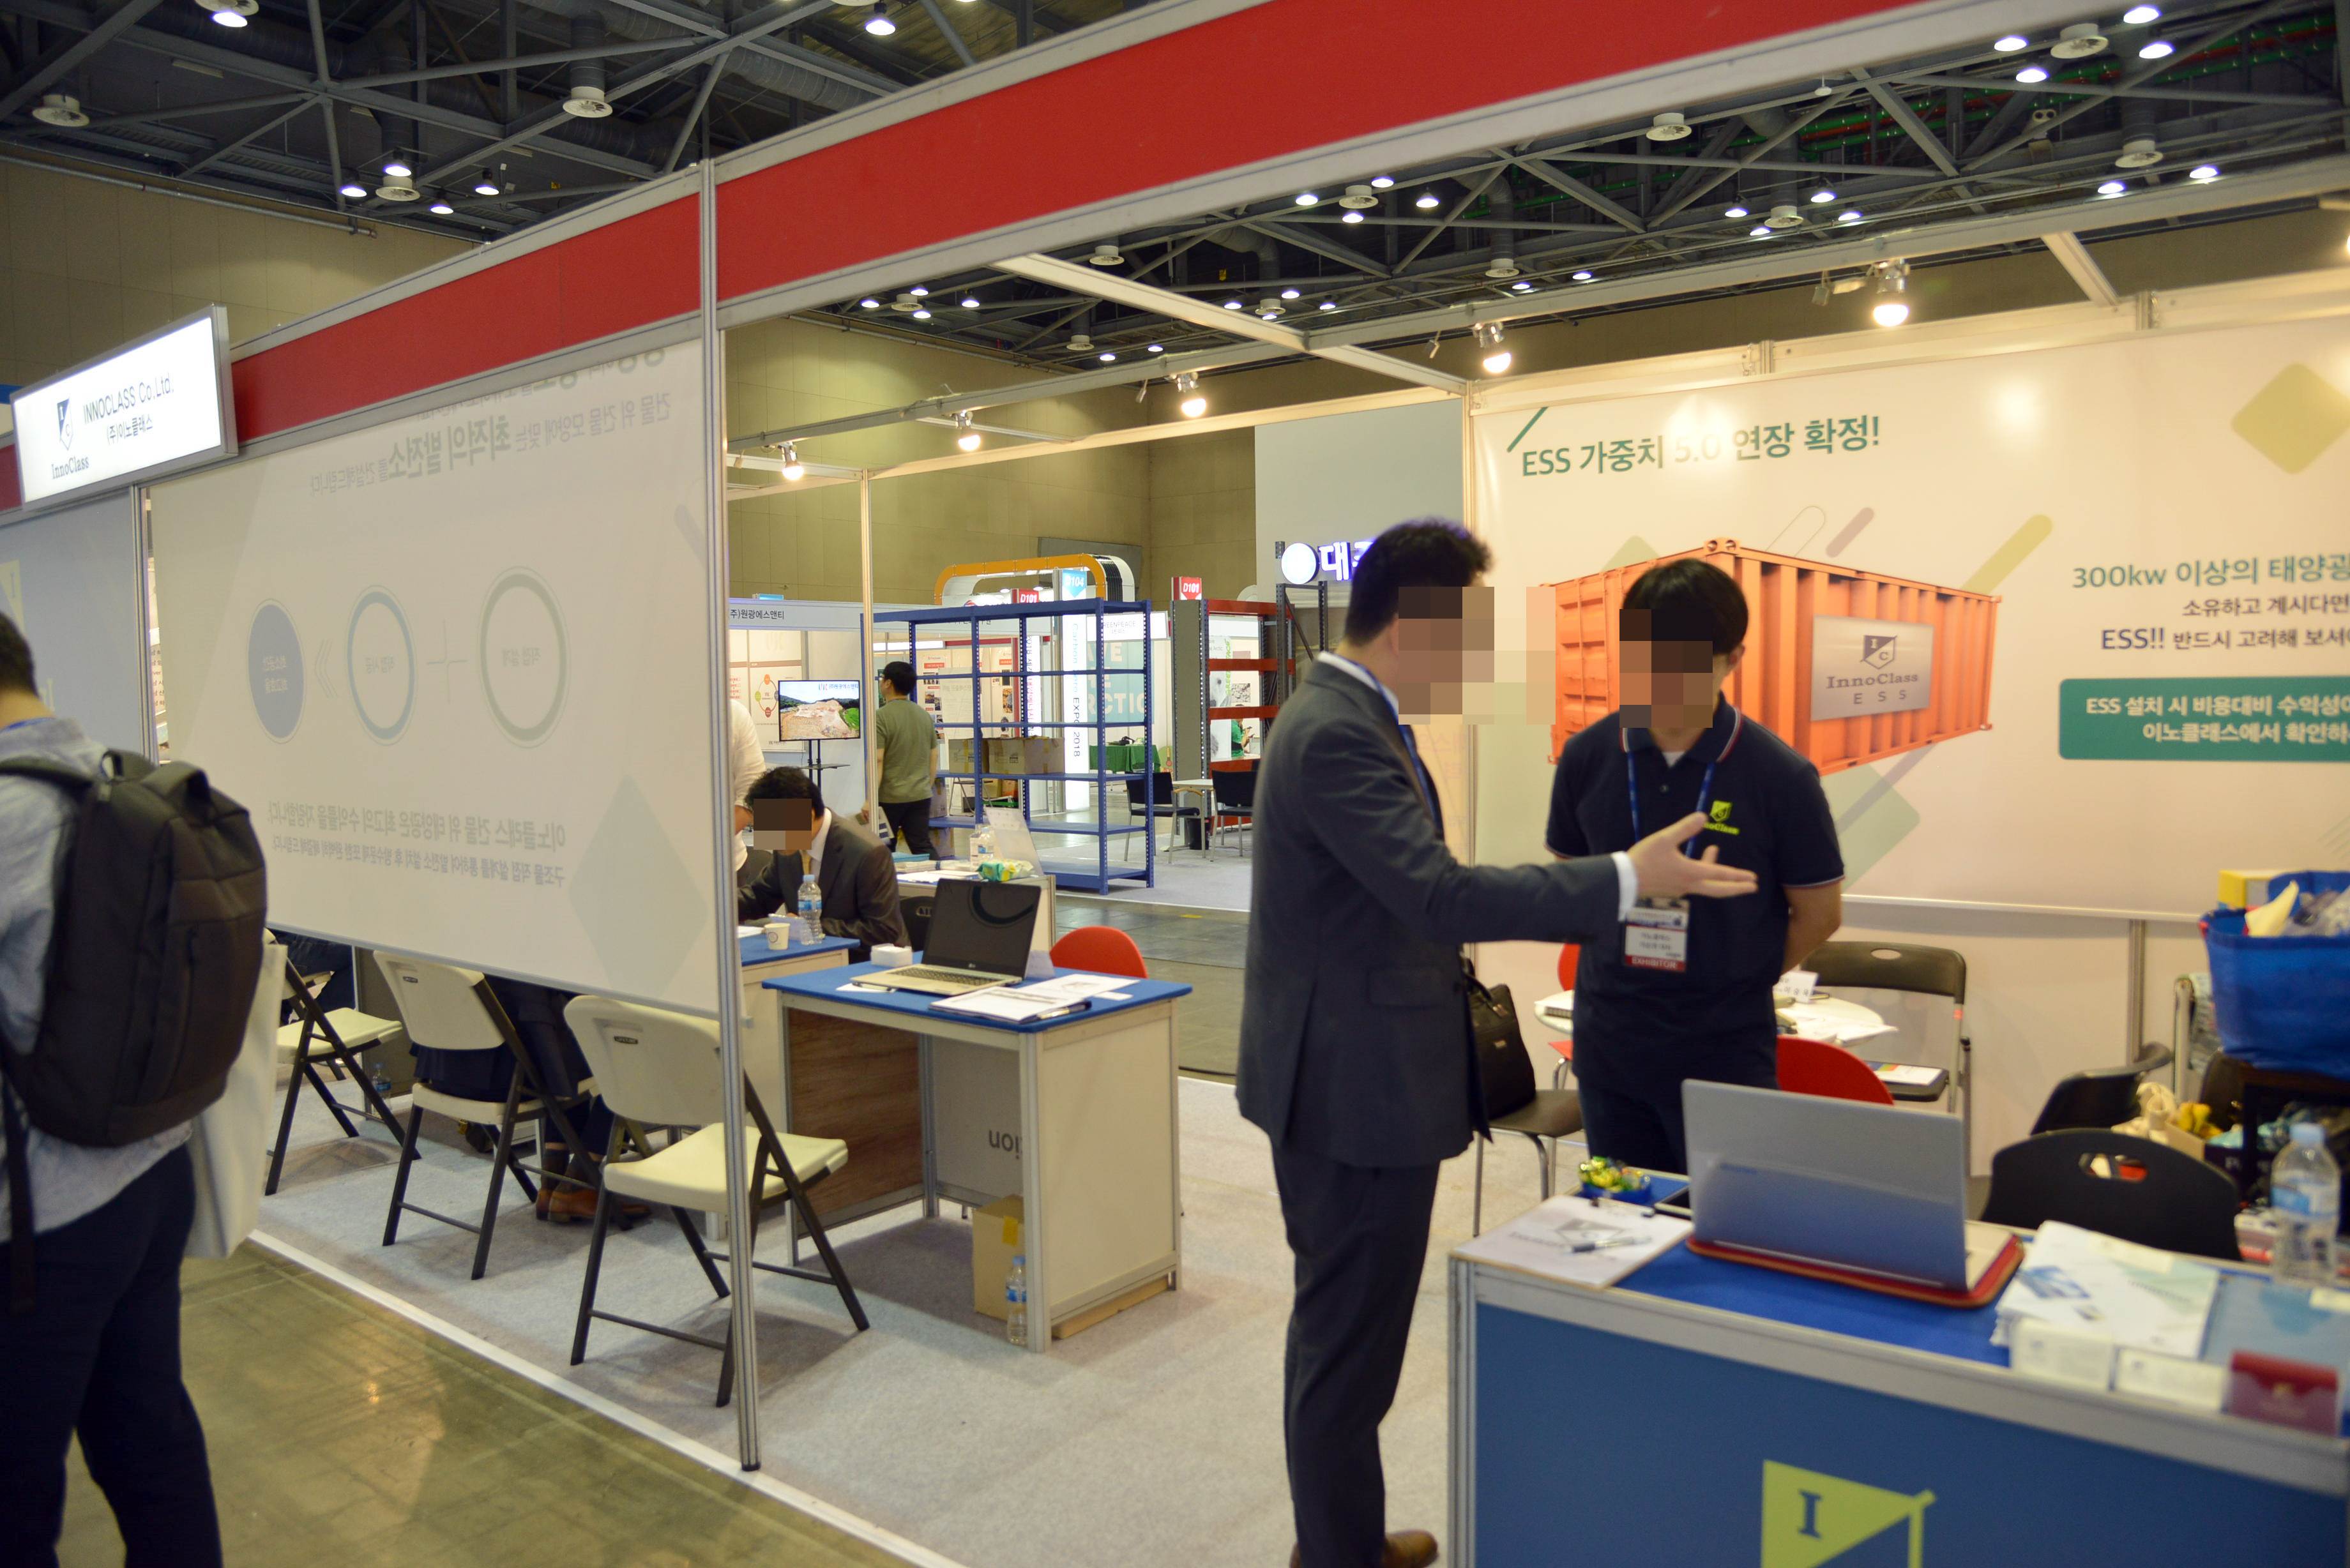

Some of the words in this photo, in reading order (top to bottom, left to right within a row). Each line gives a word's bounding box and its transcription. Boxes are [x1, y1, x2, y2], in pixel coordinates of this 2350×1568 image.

[84, 386, 135, 425] INNOCLASS
[107, 414, 153, 444] (주)이노클래스
[1522, 448, 1571, 476] ESS
[1580, 435, 1664, 474] 가중치
[1674, 433, 1722, 464] 5.0
[1732, 422, 1795, 461] 연장
[1804, 414, 1880, 455] 확정!
[52, 456, 89, 479] InnoClass
[2072, 563, 2167, 589] 300kw
[2176, 556, 2259, 587] 이상의
[1020, 594, 1038, 603] D101
[1183, 582, 1200, 593] D101
[730, 609, 785, 620] 주)원광에스앤티
[2182, 597, 2261, 617] 소유하고
[2102, 627, 2165, 650] ESS!!
[2173, 629, 2231, 650] 반드시
[2236, 628, 2298, 649] 고려해
[1826, 672, 1918, 689] InnoClass
[2086, 697, 2121, 714] ESS
[2125, 695, 2164, 716] 설치
[2168, 696, 2188, 716] 시
[2193, 695, 2273, 716] 비용대비
[2142, 721, 2280, 743] 이노클래스에서
[2285, 721, 2350, 744] 확인하
